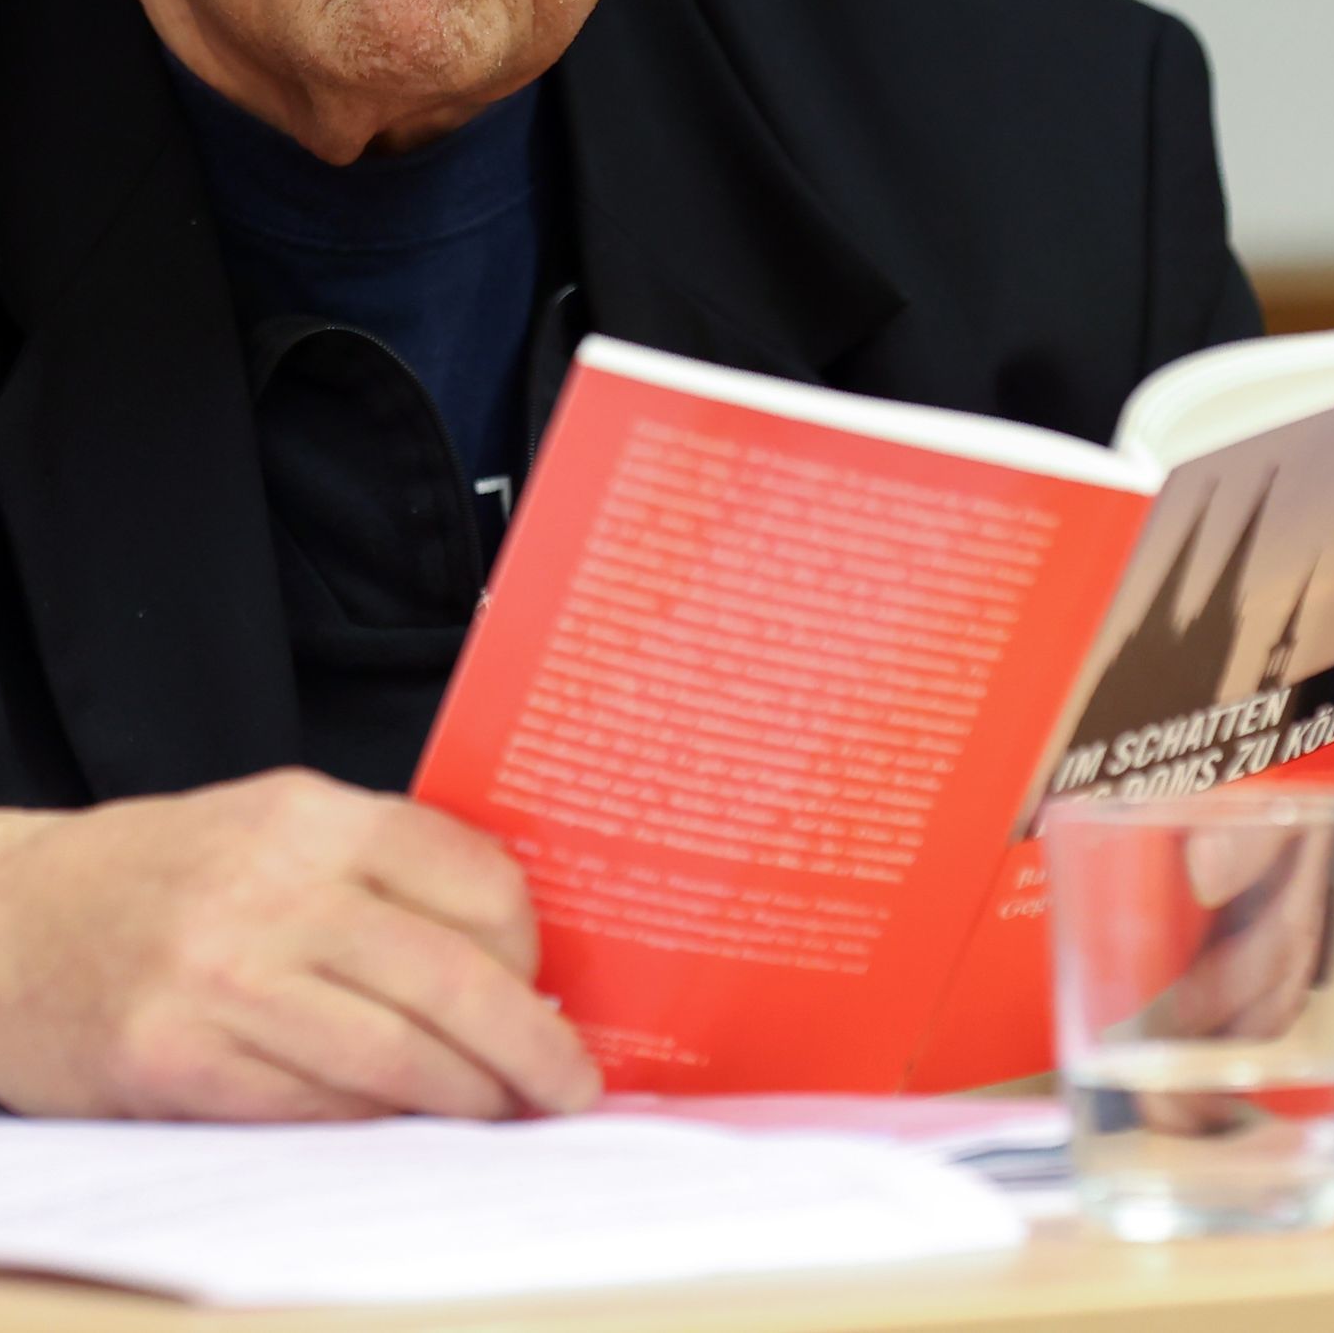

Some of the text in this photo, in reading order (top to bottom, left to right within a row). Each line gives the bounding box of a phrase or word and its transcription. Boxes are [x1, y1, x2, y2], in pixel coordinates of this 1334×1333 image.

[1052, 688, 1292, 793] IM SCHATTEN
[1119, 750, 1224, 804] DOMS
[1226, 733, 1281, 782] ZU
